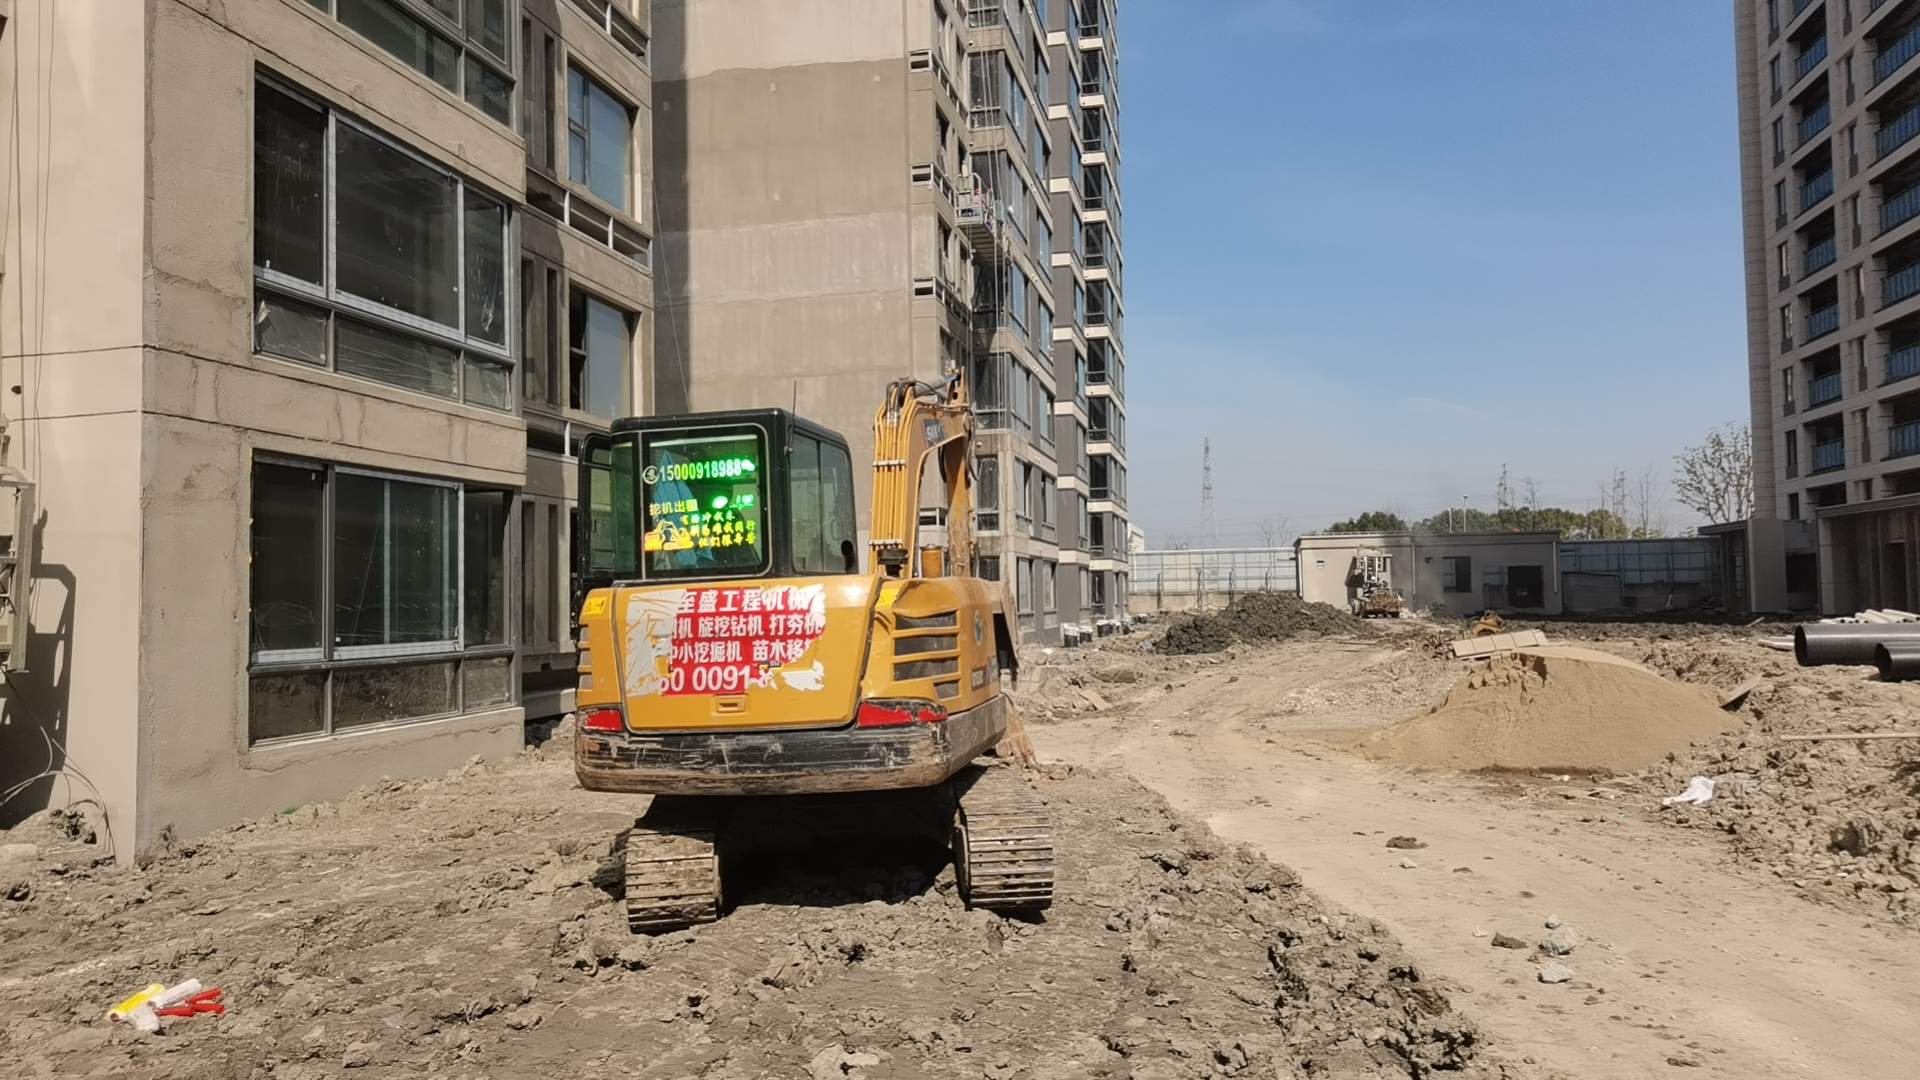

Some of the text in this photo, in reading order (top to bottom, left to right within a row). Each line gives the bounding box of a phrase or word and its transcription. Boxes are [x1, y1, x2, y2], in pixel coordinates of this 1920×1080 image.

[699, 615, 764, 638] 旋挖钻机
[769, 613, 824, 636] 打夯机
[753, 638, 811, 662] 苗木移
